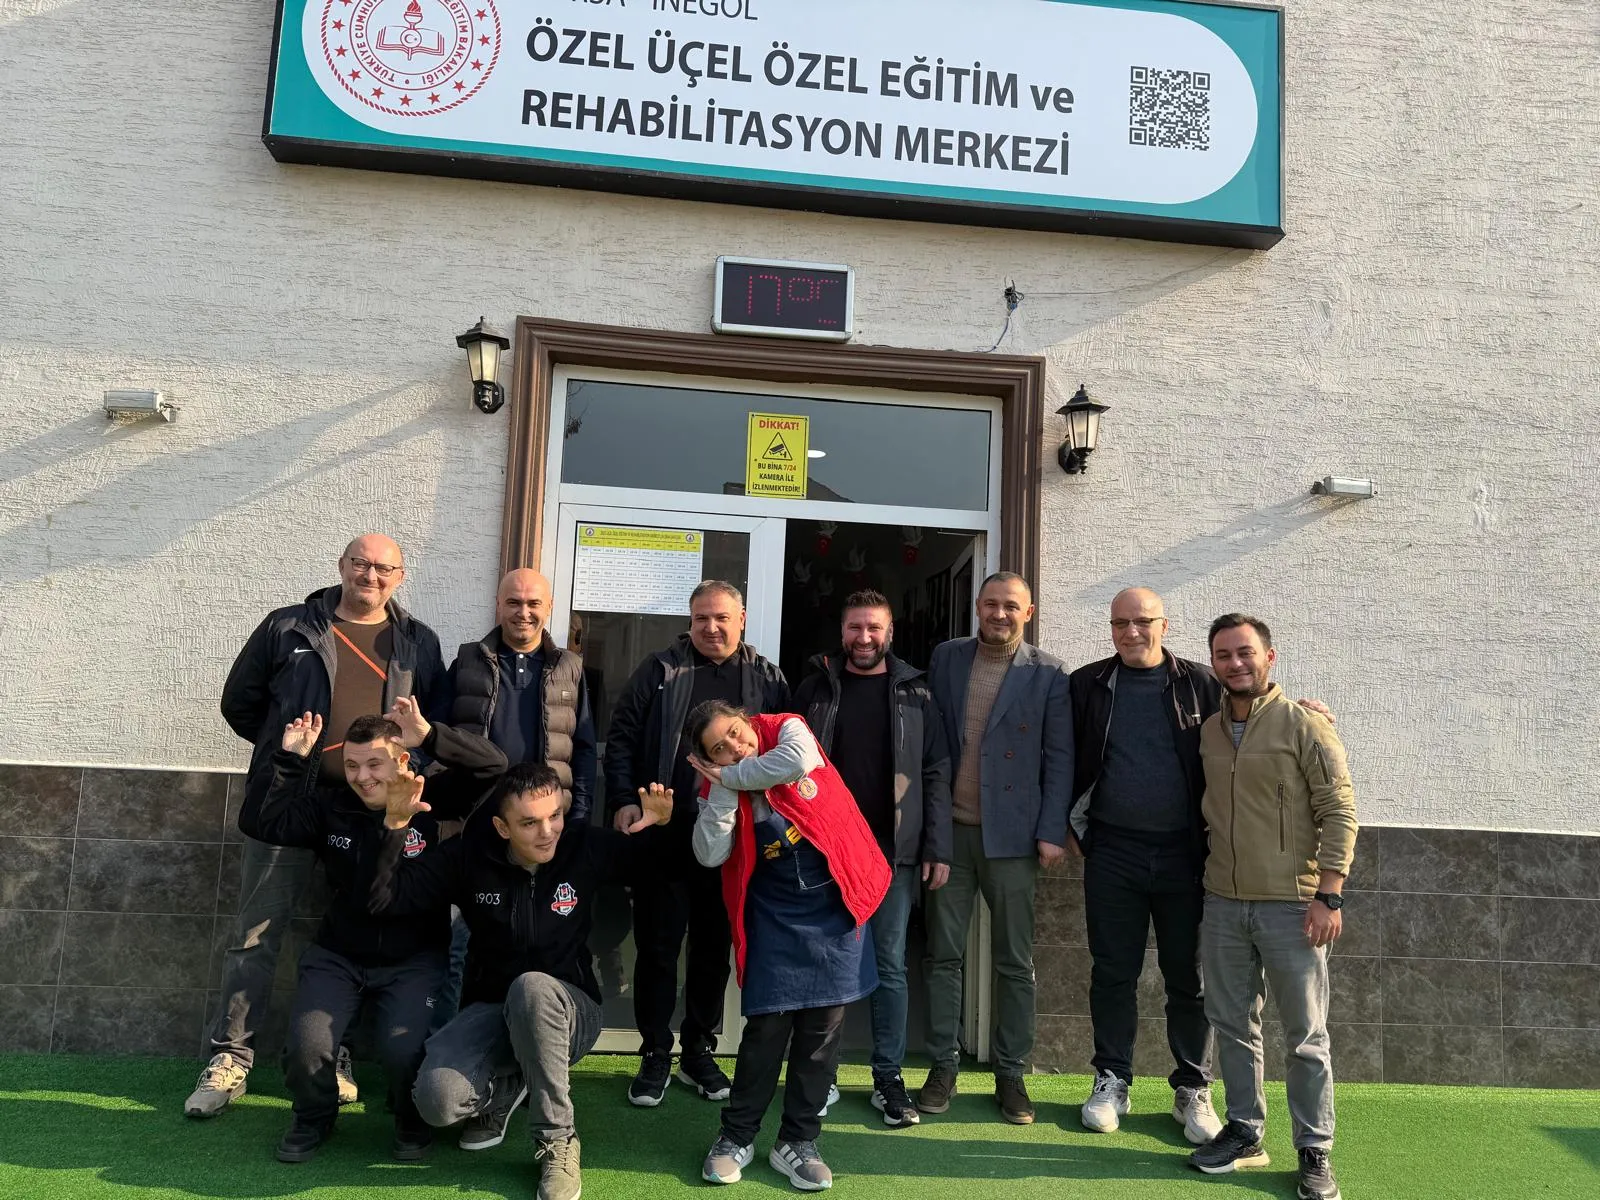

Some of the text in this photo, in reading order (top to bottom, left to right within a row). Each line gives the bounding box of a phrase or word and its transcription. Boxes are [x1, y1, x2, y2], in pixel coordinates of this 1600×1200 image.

[356, 42, 395, 82] TÜRKİYE
[422, 37, 468, 85] BAKANLIĞI
[526, 16, 1074, 114] ÖZEL ÜÇEL ÖZEL EĞİTİM ve
[521, 89, 1069, 176] REHABİLİTASYON MERKEZİ
[759, 418, 799, 430] DİKKAT!
[768, 462, 782, 470] BİNA
[760, 473, 794, 482] KAMERA İLE
[753, 482, 800, 492] İZLENMEKTEDİR!
[327, 834, 352, 850] 1903
[475, 892, 501, 905] 1903
